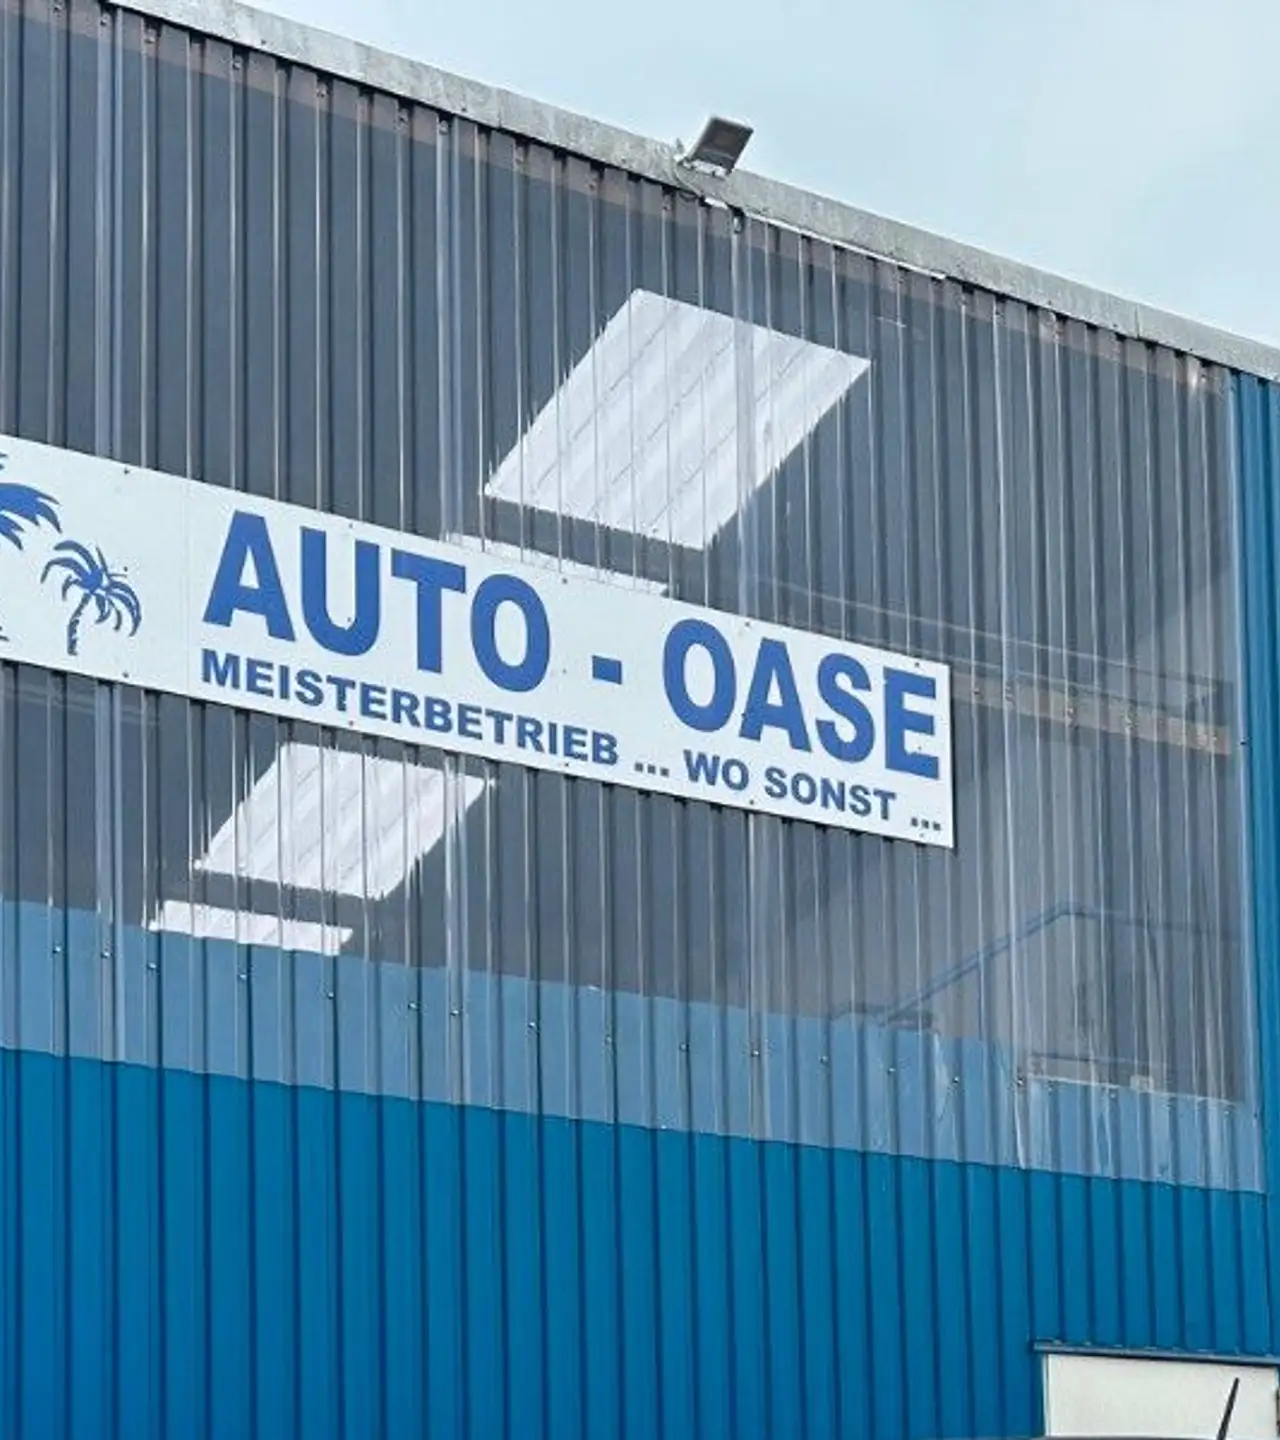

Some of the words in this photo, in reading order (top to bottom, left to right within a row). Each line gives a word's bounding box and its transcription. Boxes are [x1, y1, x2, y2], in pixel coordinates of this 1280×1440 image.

[200, 648, 619, 767] MEISTERBETRIEB
[683, 748, 750, 794] WO
[764, 762, 898, 822] SONST
[202, 511, 552, 694] AUTO
[592, 655, 623, 685] -
[662, 618, 941, 781] OASE
